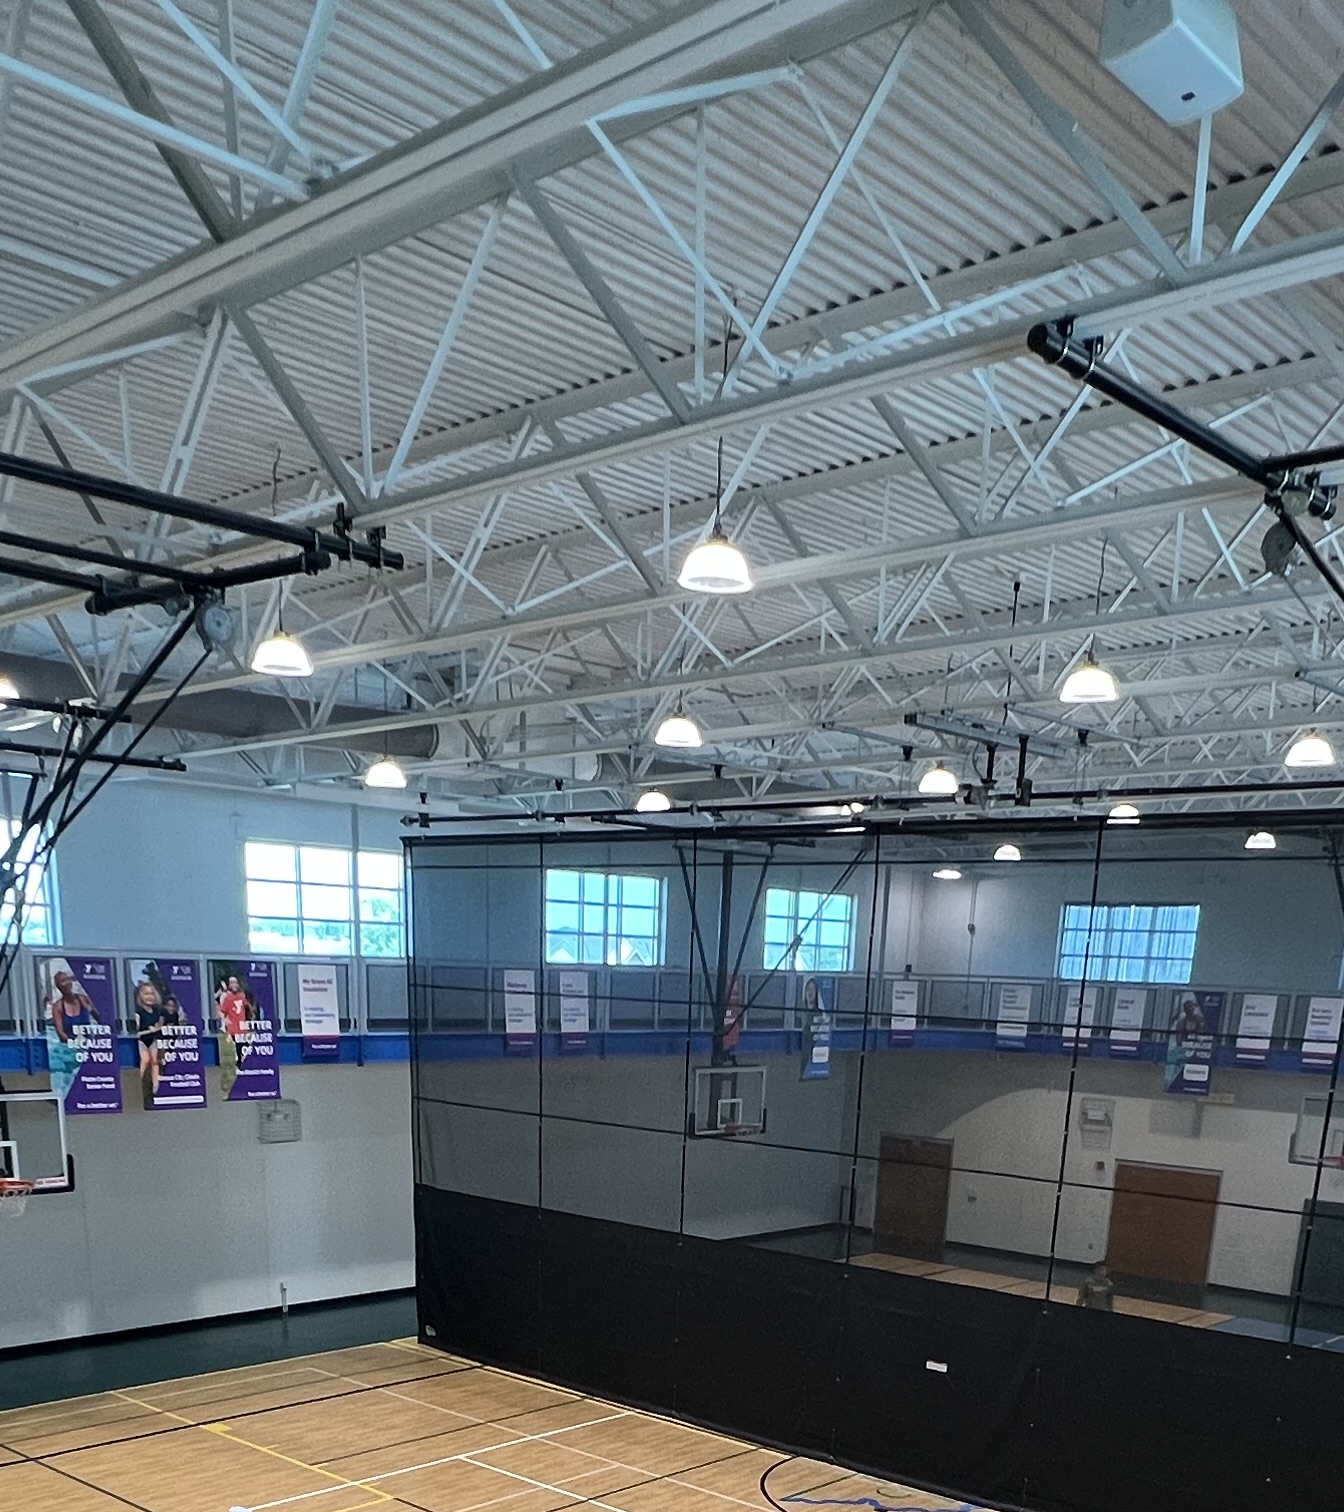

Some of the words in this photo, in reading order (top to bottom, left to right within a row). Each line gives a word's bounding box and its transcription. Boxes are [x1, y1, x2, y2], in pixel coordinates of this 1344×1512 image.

[72, 1024, 112, 1036] BETTER
[161, 1025, 197, 1036] BETTER
[239, 1020, 272, 1031] BETTER
[67, 1038, 112, 1050] BECAUSE
[234, 1033, 273, 1044] BECAUSE
[157, 1039, 198, 1050] BECAUSE
[241, 1046, 253, 1056] OF
[255, 1045, 274, 1056] YOU
[75, 1052, 89, 1063] OF
[91, 1052, 114, 1063] YOU
[164, 1052, 176, 1063] OF
[179, 1051, 199, 1062] YOU
